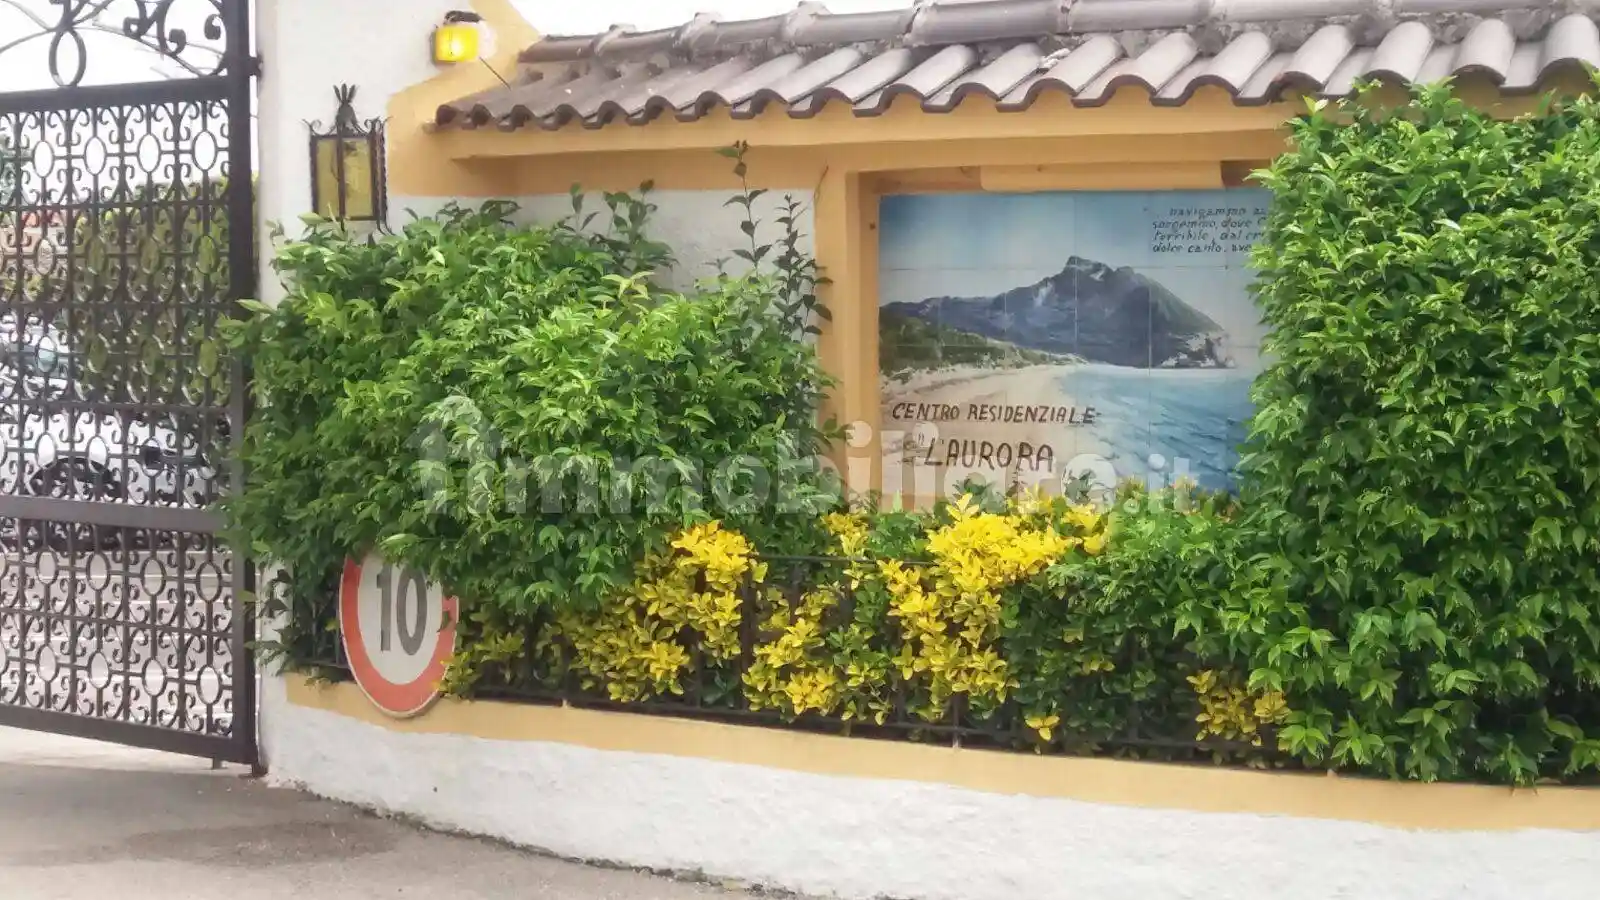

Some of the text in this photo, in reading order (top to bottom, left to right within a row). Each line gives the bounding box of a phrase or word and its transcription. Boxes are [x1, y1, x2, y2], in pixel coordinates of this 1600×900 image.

[892, 401, 1097, 424] CENTRO RESIDENZIALE
[376, 562, 428, 656] 10
